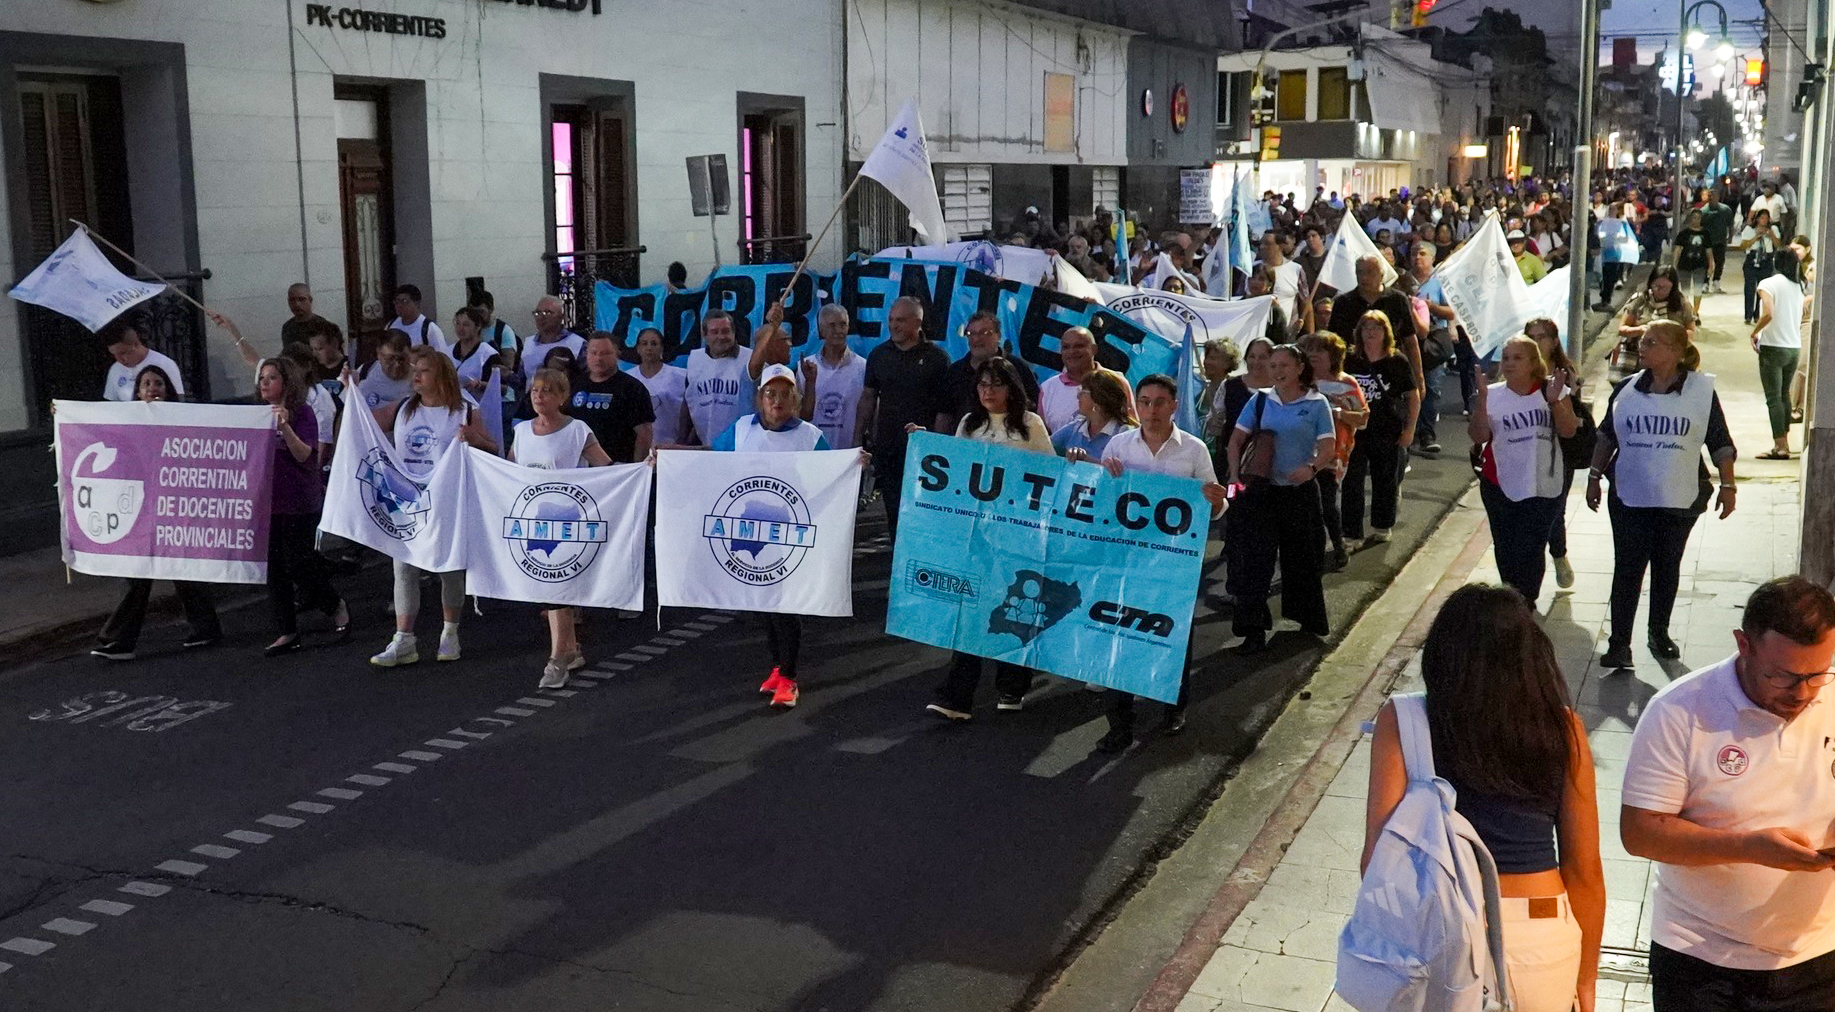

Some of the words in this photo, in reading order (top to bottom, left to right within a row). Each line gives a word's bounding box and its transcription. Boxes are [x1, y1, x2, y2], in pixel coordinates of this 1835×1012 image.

[306, 4, 446, 39] PK-CORRIENTES
[1113, 296, 1196, 321] CORRIENTES
[1626, 415, 1691, 437] SANIDAD
[160, 437, 247, 461] ASOCIACION
[159, 466, 248, 490] CORRENTINA
[729, 480, 798, 505] CORRIENTES
[918, 454, 1198, 539] S.U.T.E.CO.
[157, 496, 176, 517] DE
[178, 497, 253, 520] DOCENTES
[156, 526, 255, 550] PROVINCIALES
[510, 519, 600, 540] AMET
[710, 518, 808, 544] AMET
[914, 501, 953, 514] SINDICATO
[992, 514, 1007, 523] LOS
[1008, 517, 1064, 535] TRABAJAORES
[1066, 530, 1077, 538] DE
[1079, 532, 1088, 540] LA
[1089, 534, 1136, 546] EDUCACION
[1138, 541, 1149, 549] DE
[1150, 543, 1199, 557] CORRIENTES
[521, 558, 570, 579] REGIONAL
[570, 561, 583, 572] VI
[725, 559, 776, 582] REGIONAL
[776, 565, 788, 576] VI
[915, 568, 975, 598] CTERA
[1088, 600, 1175, 638] CTA
